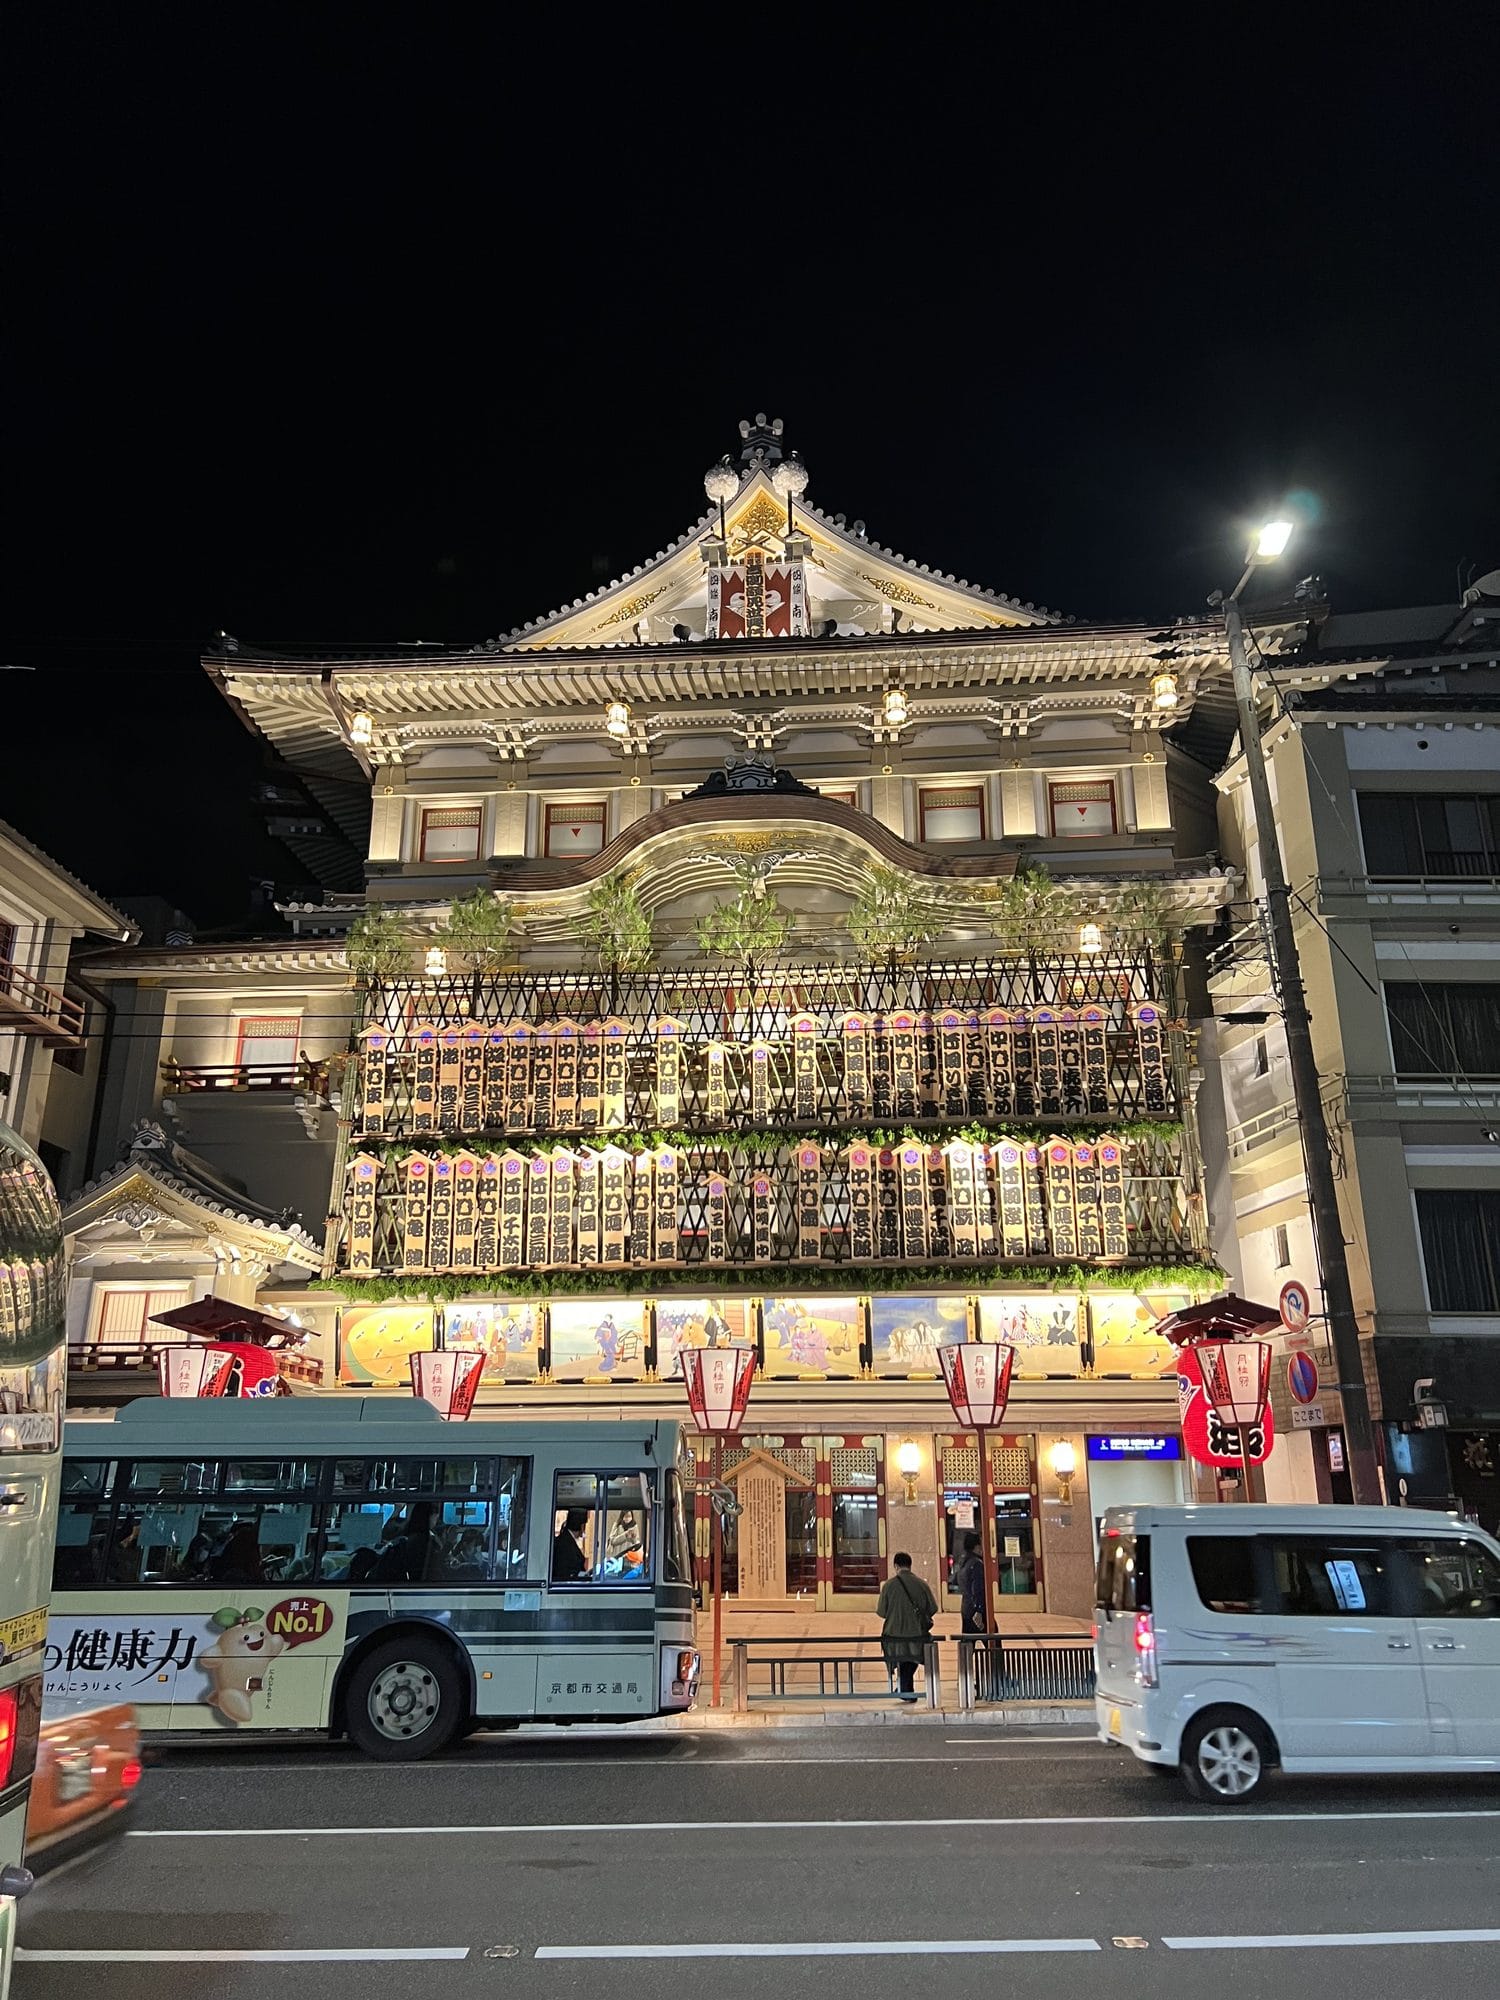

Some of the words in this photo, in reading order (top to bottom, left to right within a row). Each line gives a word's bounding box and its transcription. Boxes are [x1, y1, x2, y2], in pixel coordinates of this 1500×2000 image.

[1293, 1407, 1322, 1423] ここまで
[290, 1601, 310, 1612] 売上
[273, 1602, 326, 1634] No.1
[550, 1682, 638, 1694] 京都市交通局
